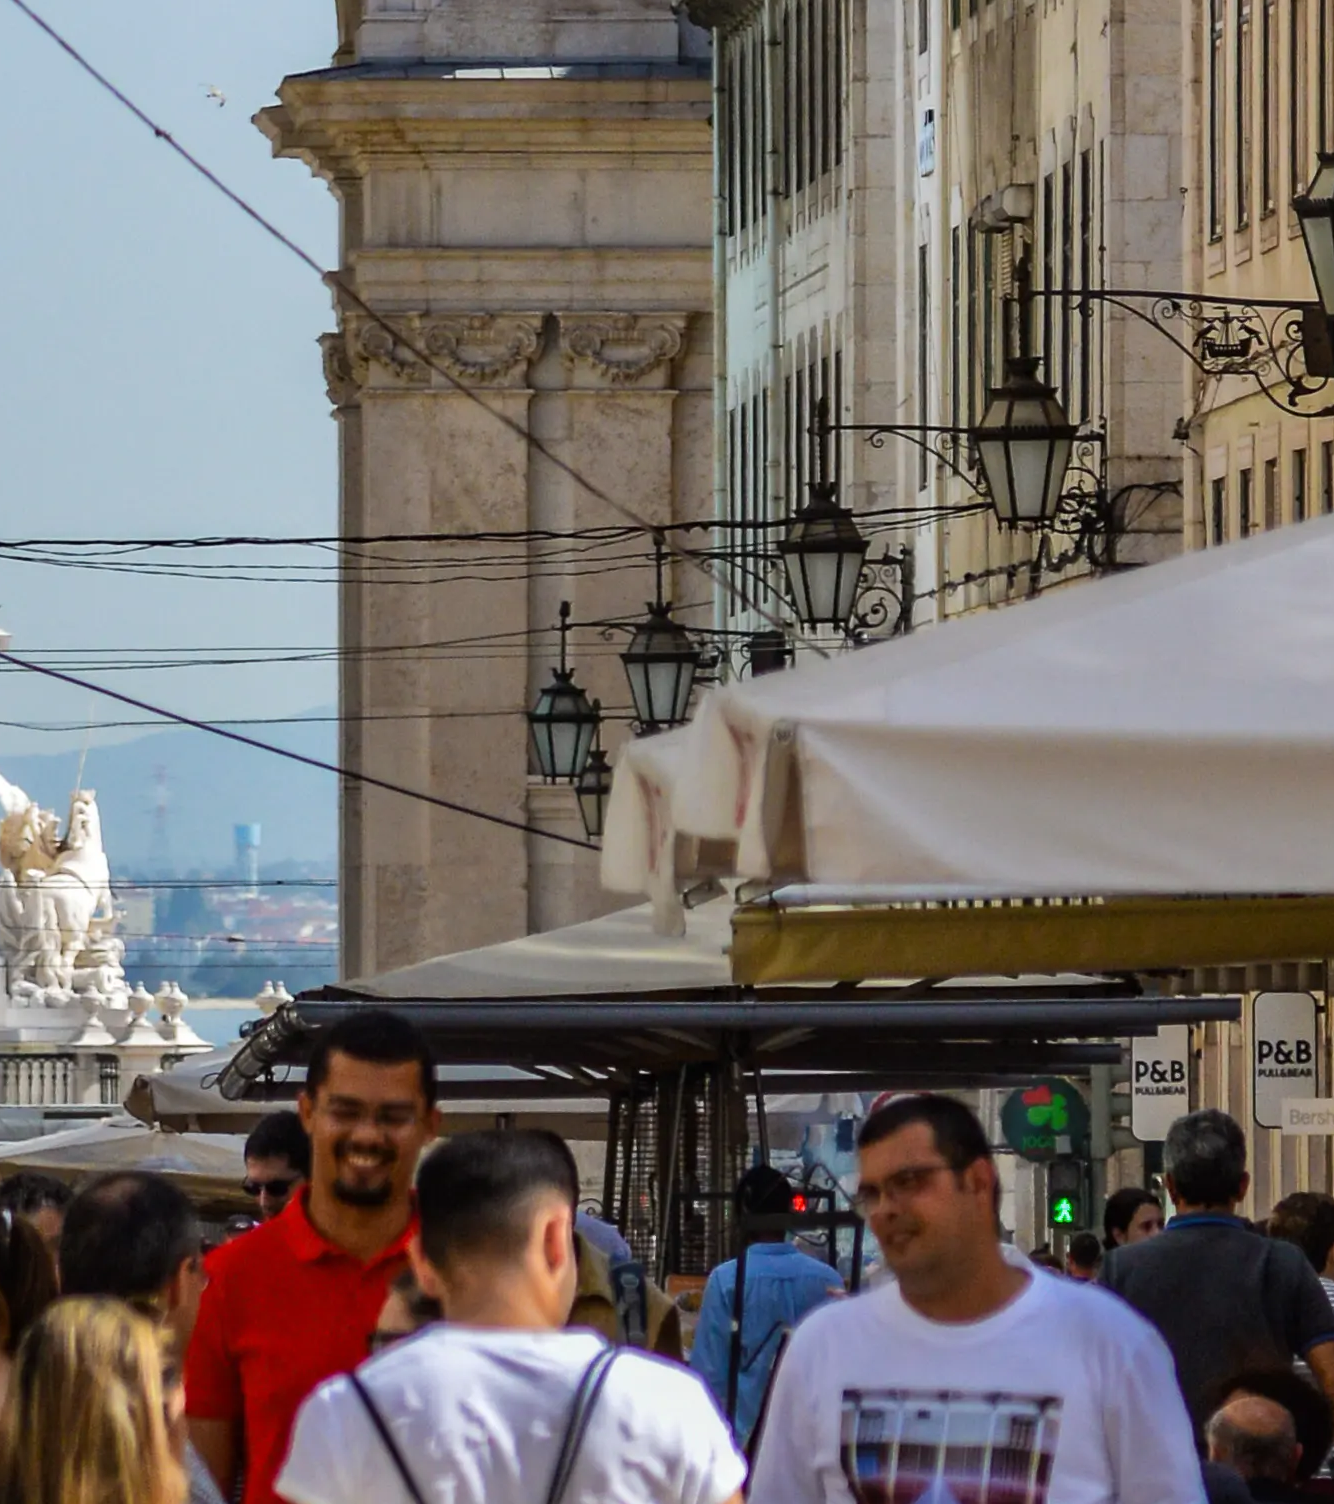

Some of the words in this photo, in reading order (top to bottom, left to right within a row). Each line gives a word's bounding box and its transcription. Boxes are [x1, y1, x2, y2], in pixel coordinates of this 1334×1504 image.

[1256, 1040, 1312, 1065] P&B
[1135, 1059, 1186, 1084] P&B
[1257, 1067, 1313, 1078] PULL&BEAR
[1135, 1085, 1187, 1096] PULL&BEAR
